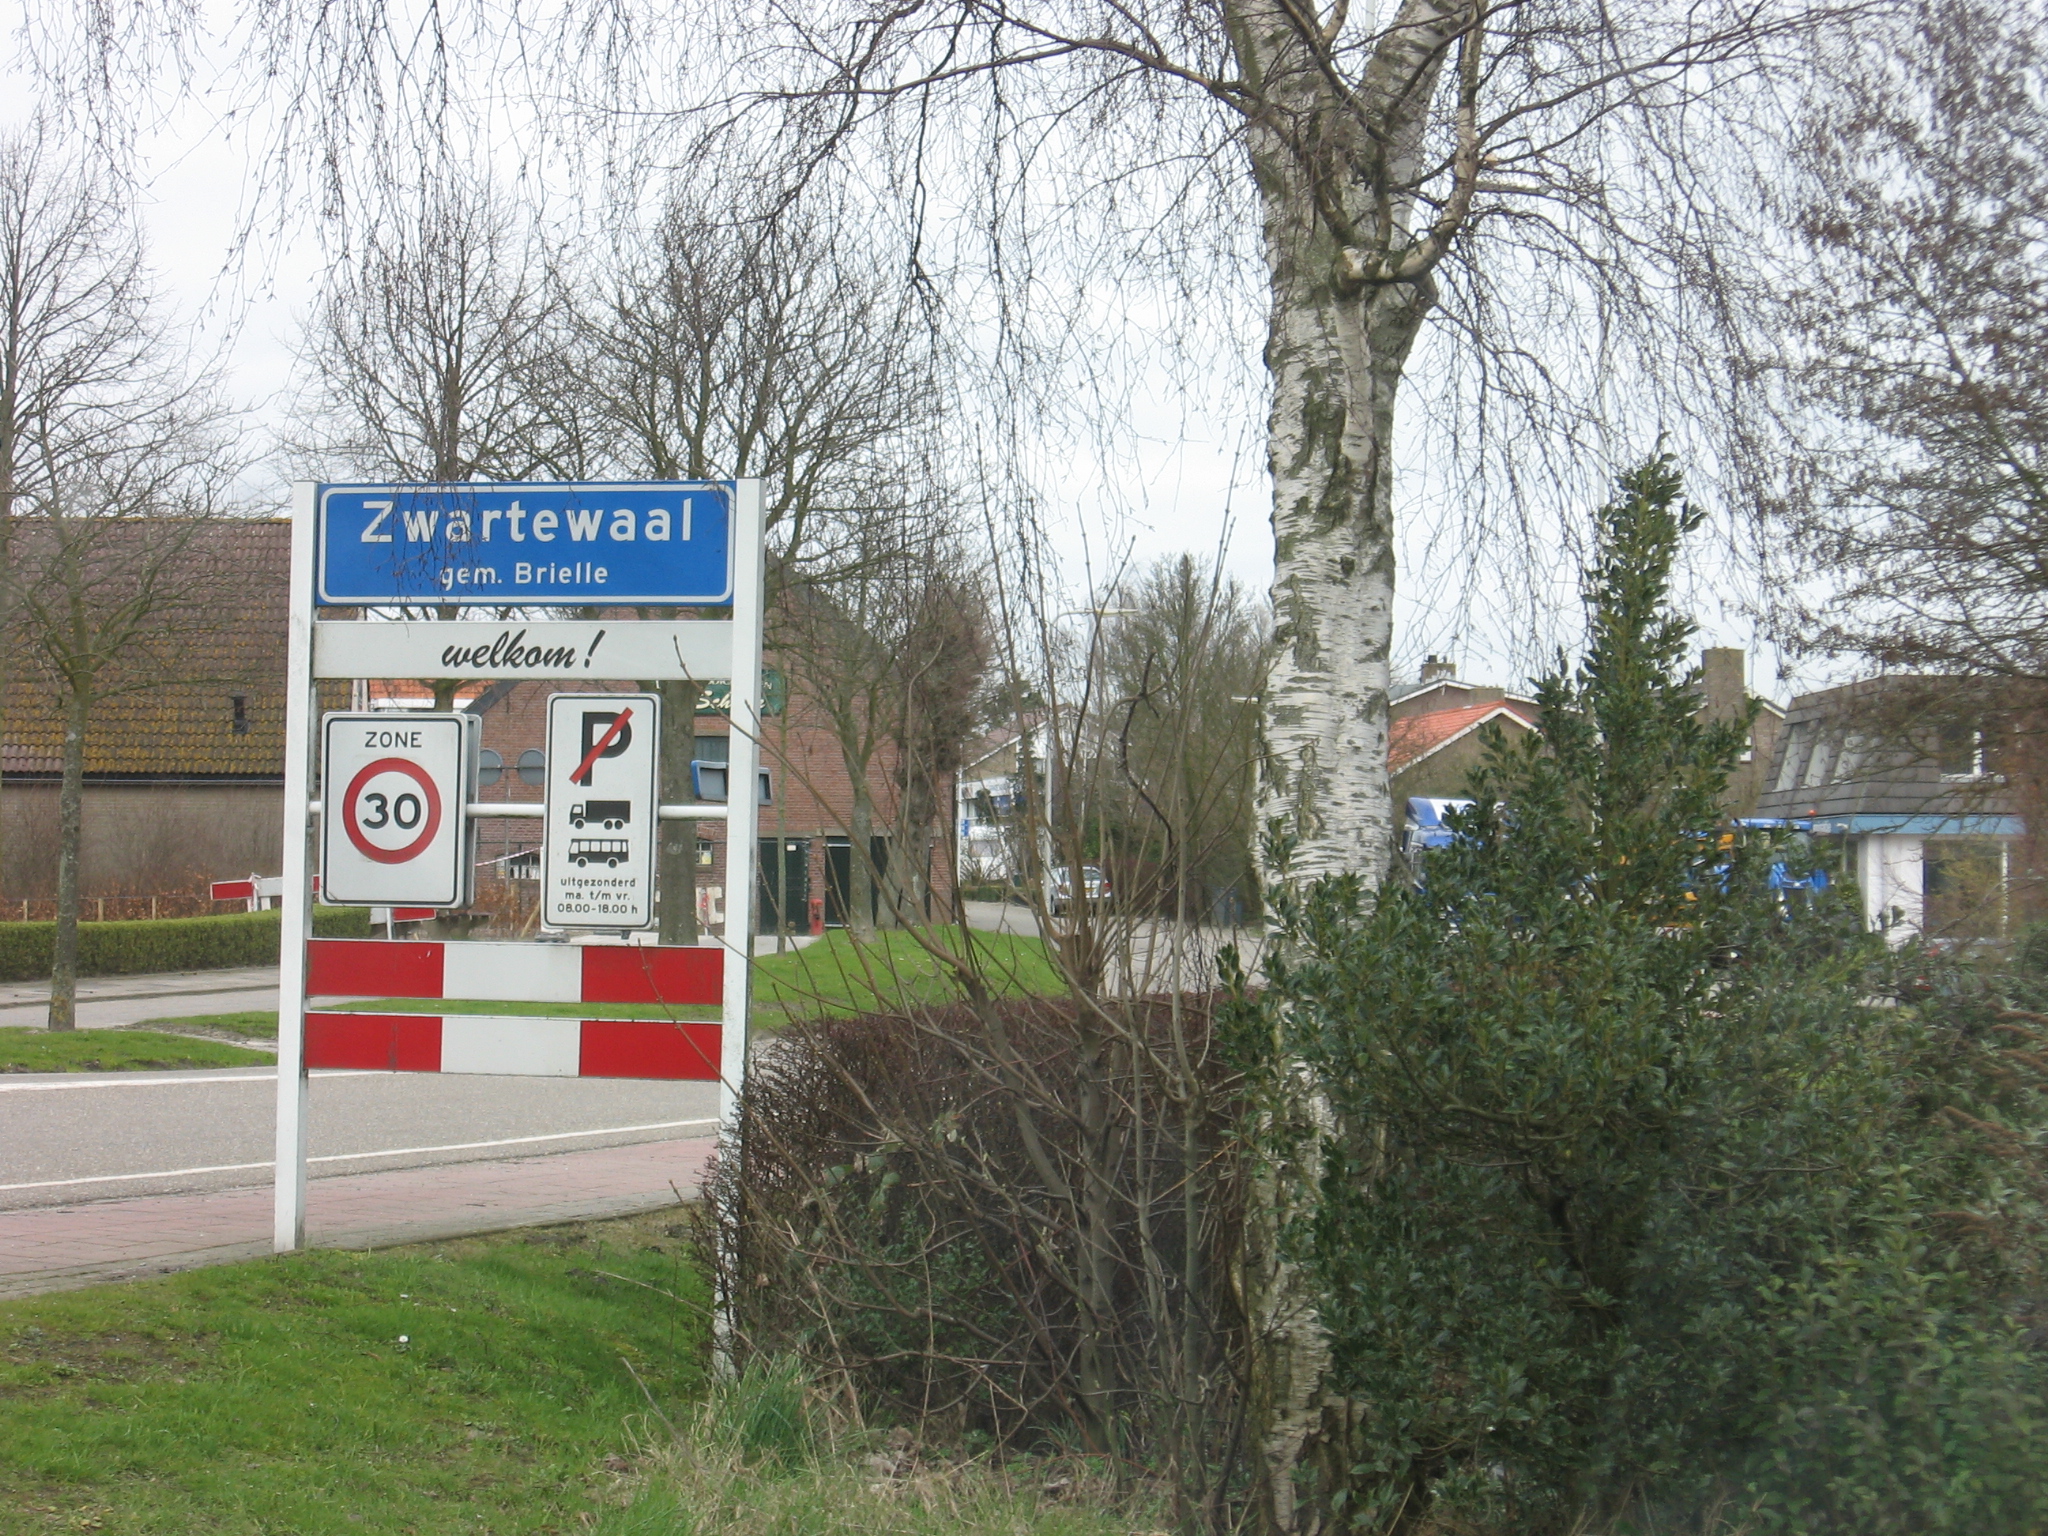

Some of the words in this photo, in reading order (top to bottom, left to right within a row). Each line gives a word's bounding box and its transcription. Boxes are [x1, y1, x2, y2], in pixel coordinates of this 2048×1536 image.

[360, 497, 693, 544] Zwartewaal
[439, 566, 503, 592] gem.
[515, 562, 609, 584] Brielle
[441, 629, 606, 669] welkom!
[364, 731, 423, 749] ZONE
[580, 711, 633, 787] P
[362, 792, 422, 830] 30
[560, 877, 636, 889] uitgezonderd
[565, 891, 585, 900] ma.
[589, 890, 612, 901] t/m
[616, 892, 631, 901] vr.
[557, 903, 628, 914] 08.00-18.00
[631, 904, 638, 915] h
